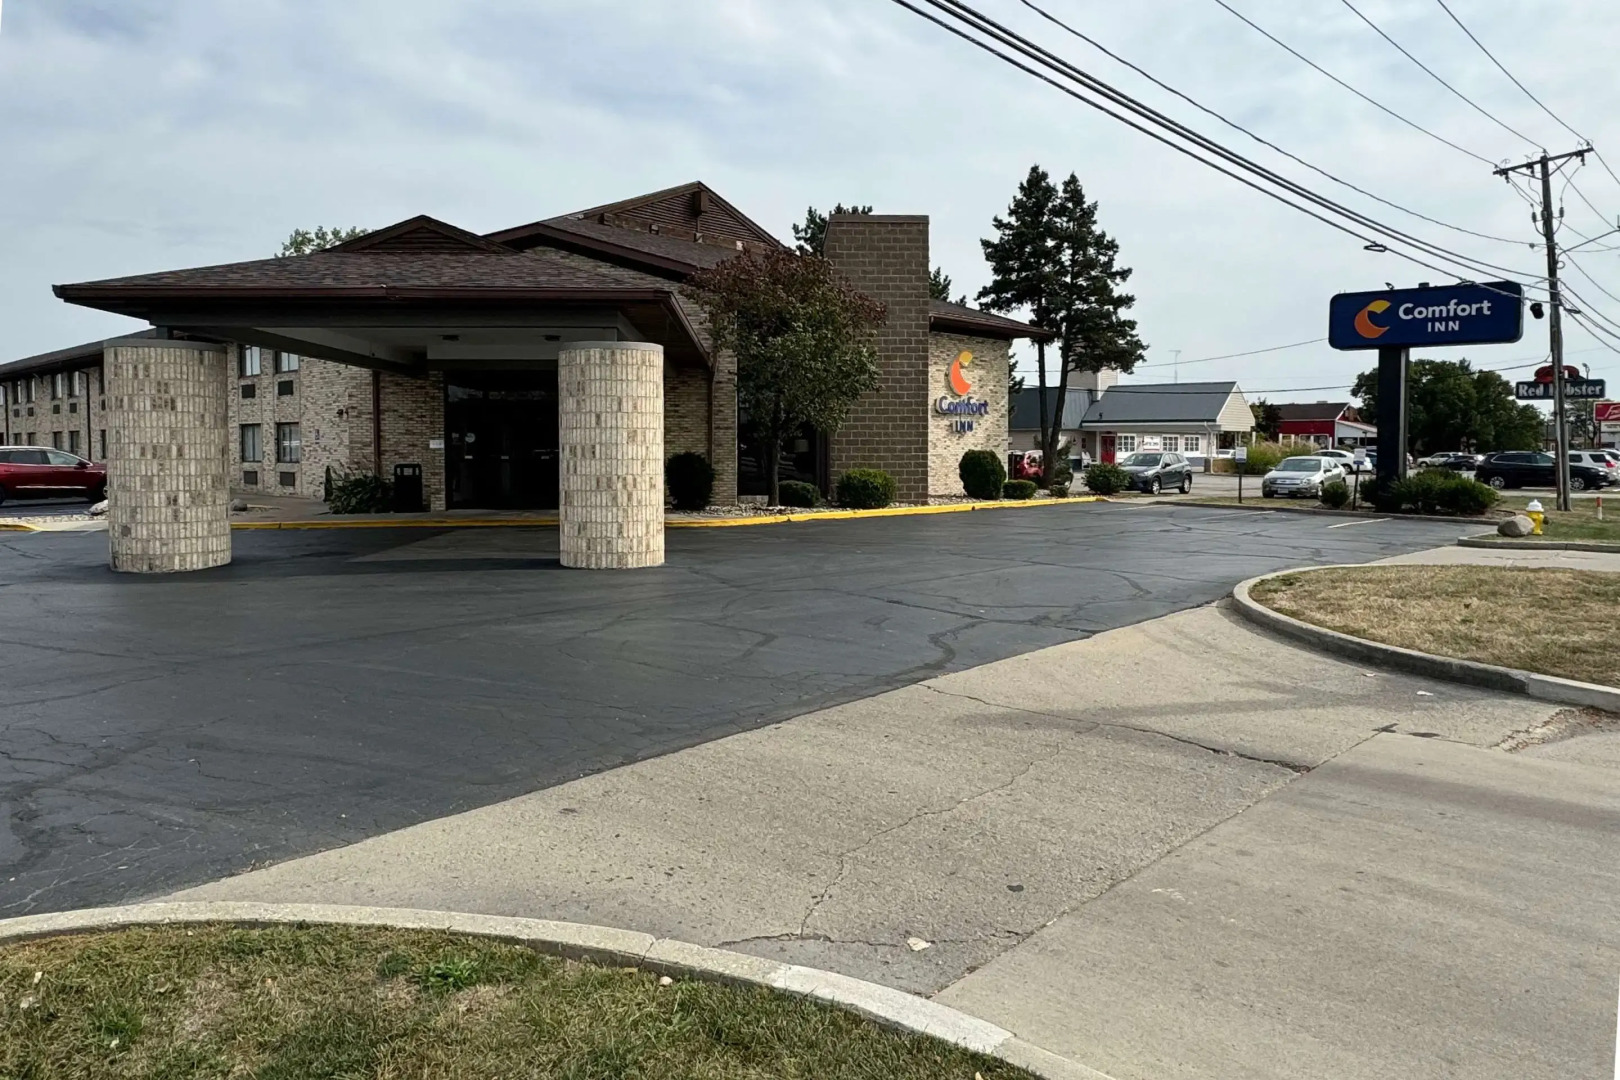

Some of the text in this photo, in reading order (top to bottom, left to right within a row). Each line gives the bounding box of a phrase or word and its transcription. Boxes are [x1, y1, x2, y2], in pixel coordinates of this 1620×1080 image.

[1398, 299, 1492, 320] Comfort
[1427, 320, 1460, 333] INN
[1518, 383, 1544, 397] Red
[938, 395, 989, 416] Comfort
[953, 420, 974, 432] INN
